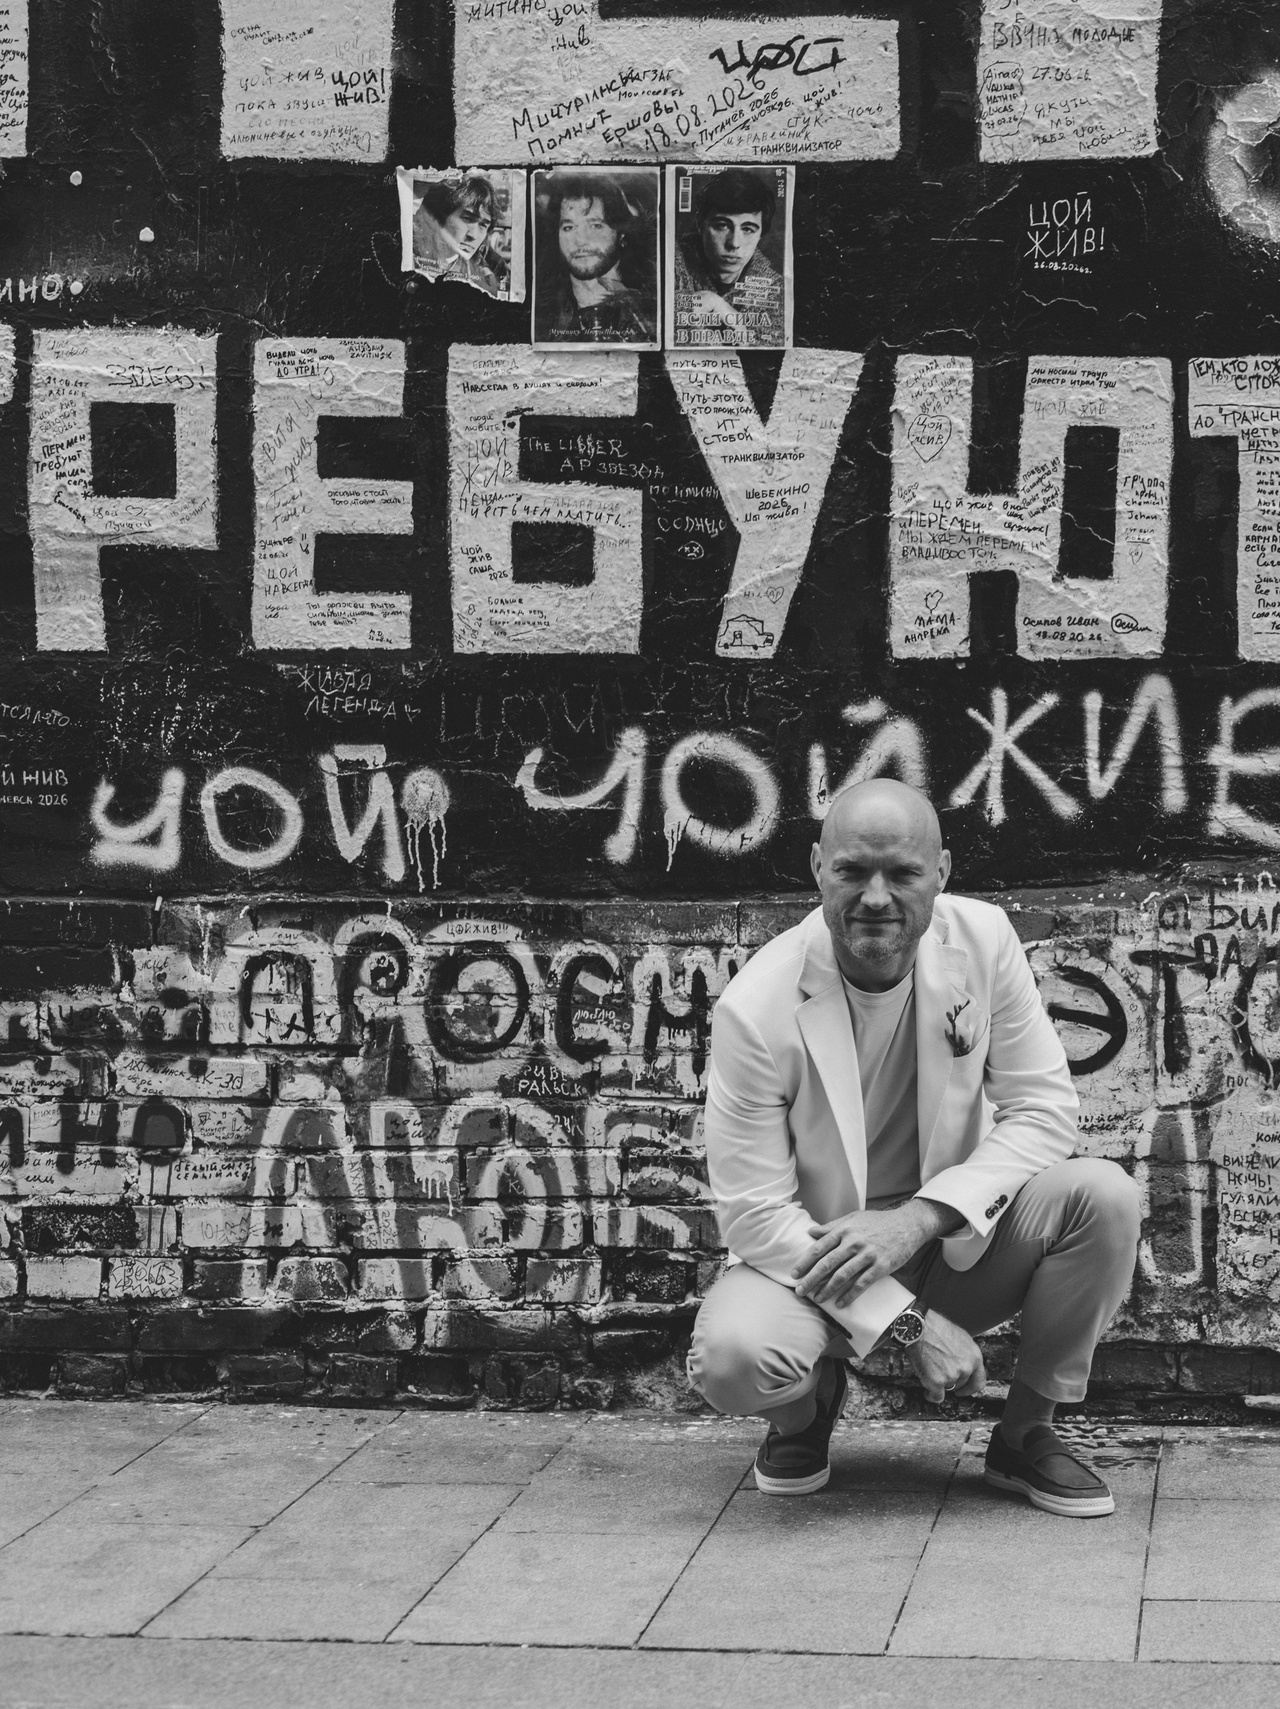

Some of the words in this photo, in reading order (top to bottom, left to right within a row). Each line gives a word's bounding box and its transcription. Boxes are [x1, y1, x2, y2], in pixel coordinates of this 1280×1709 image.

[1030, 192, 1092, 228] ЦОЙ
[1024, 227, 1104, 258] ЖИВ!
[676, 312, 723, 328] ЕСЛИ
[724, 312, 772, 328] СИЛА
[676, 330, 688, 344] В
[691, 330, 756, 345] ПРАВДЕ
